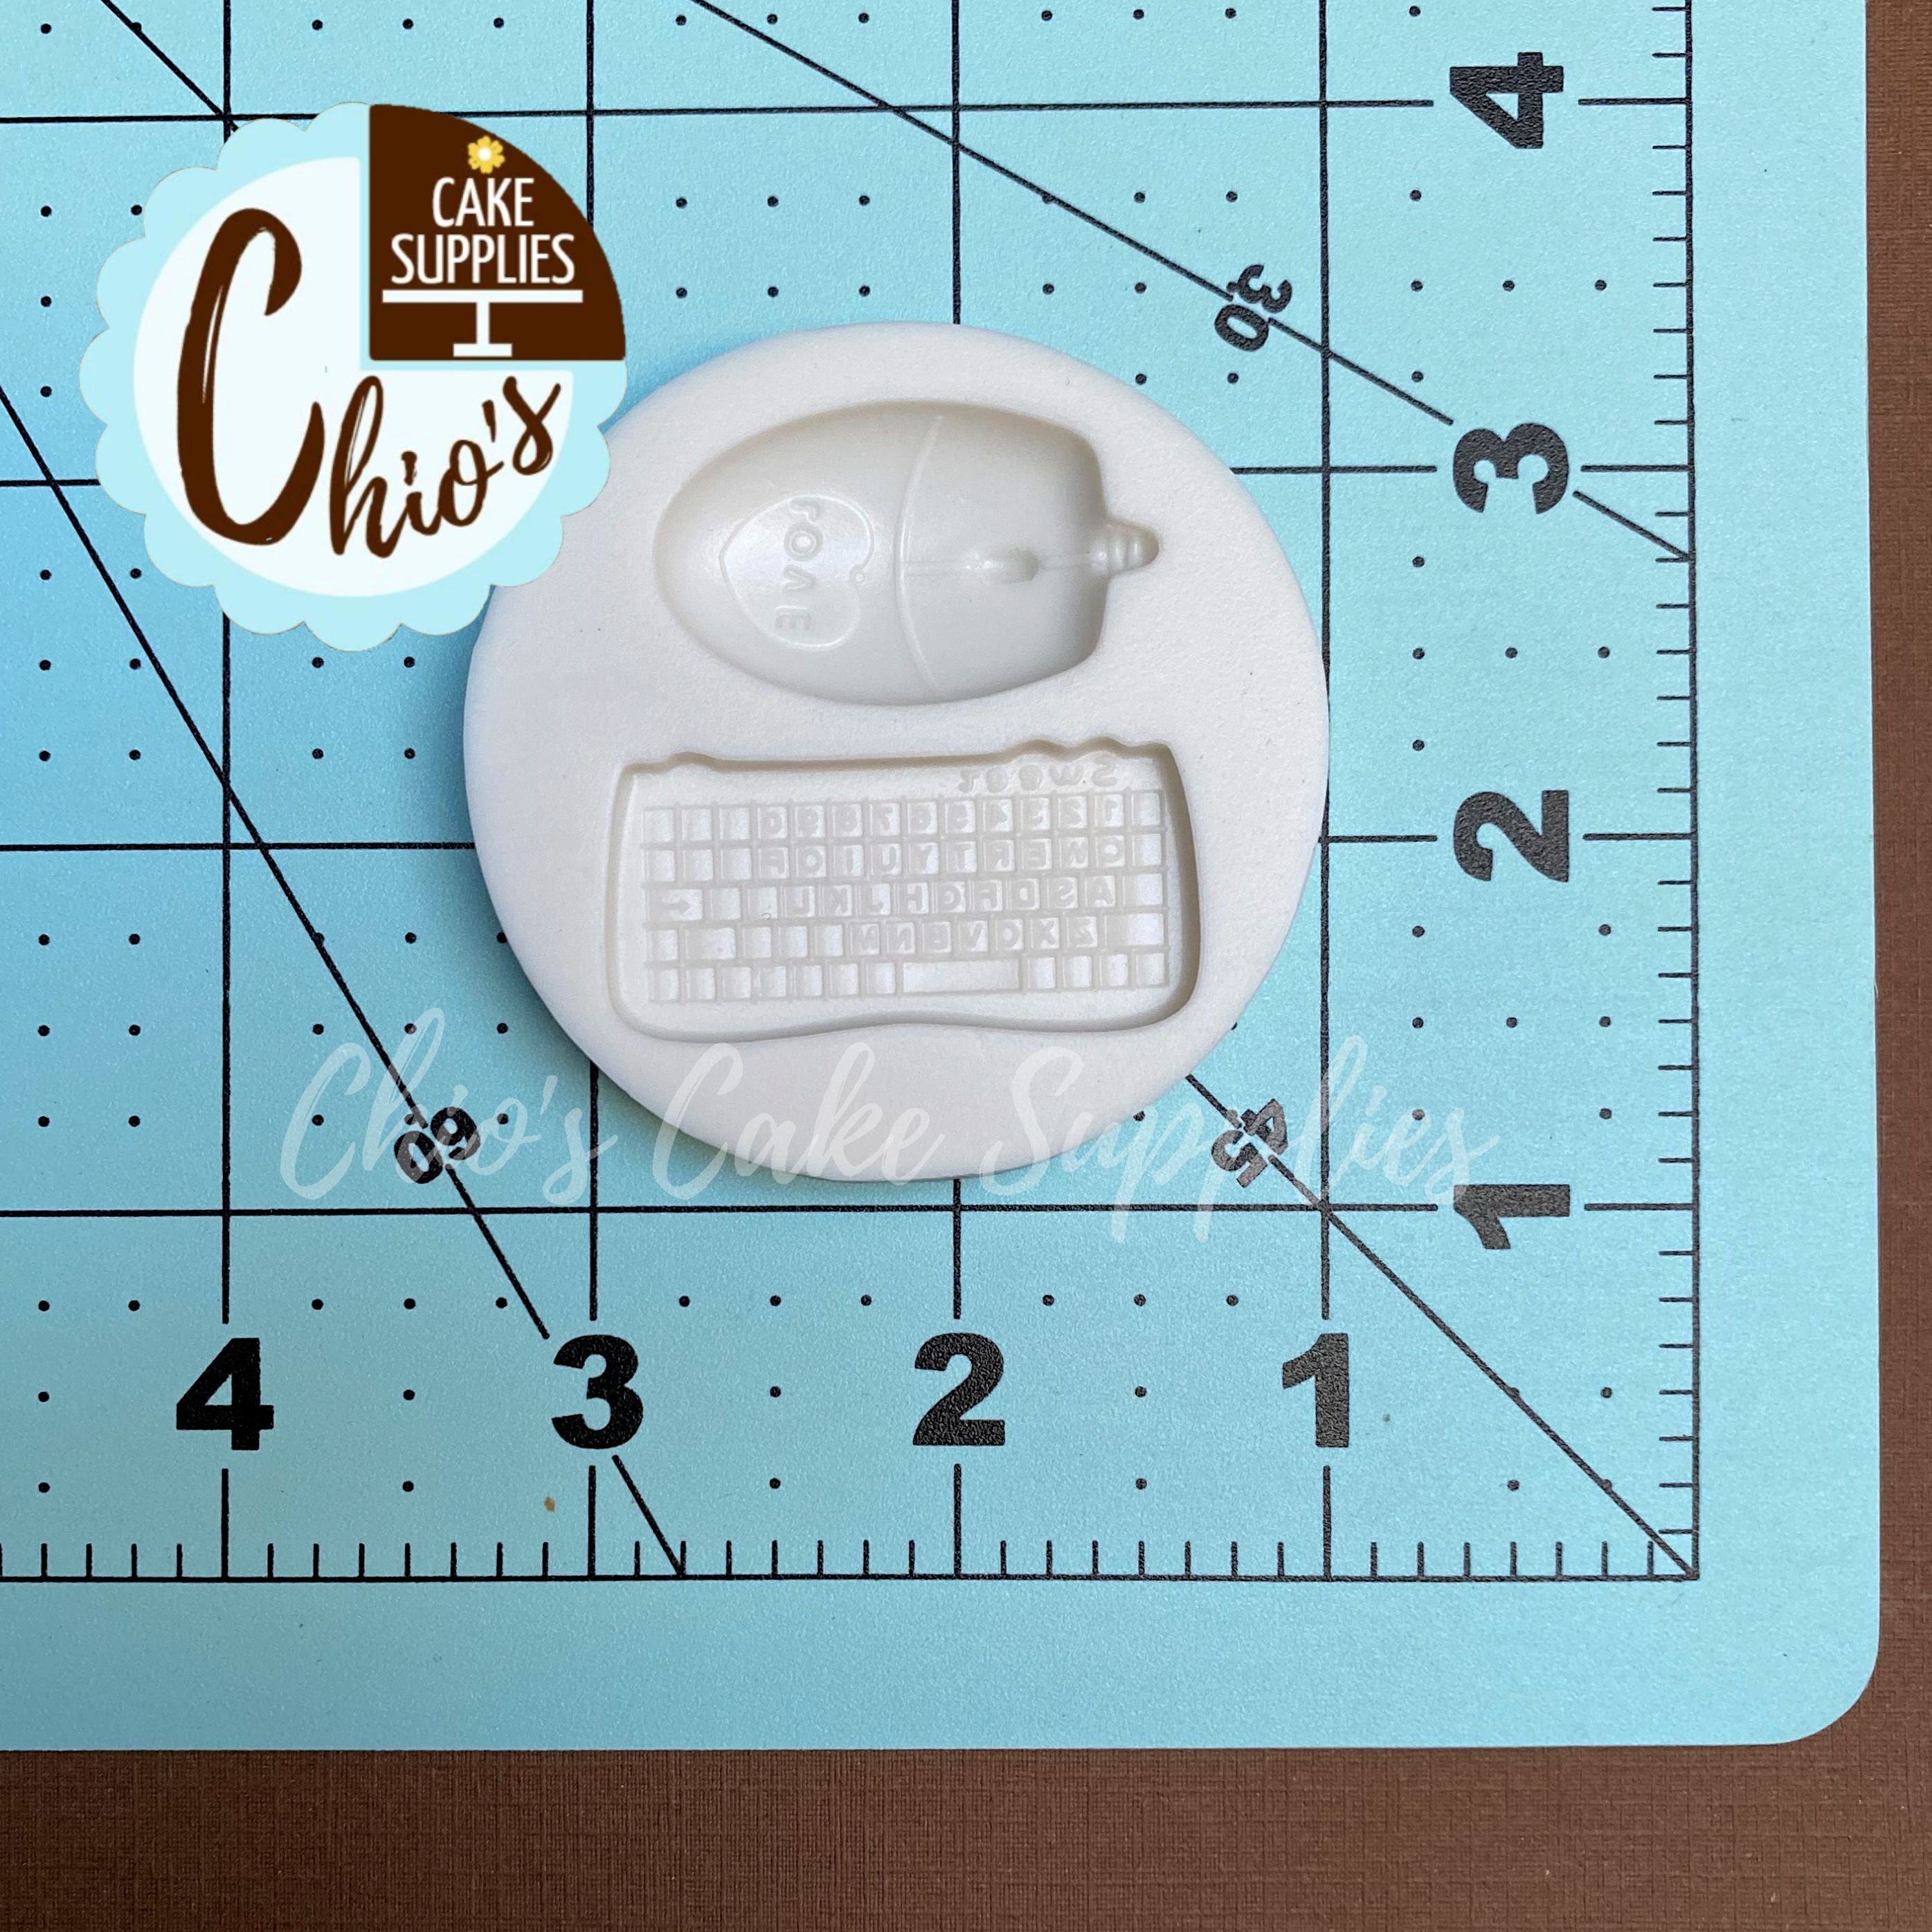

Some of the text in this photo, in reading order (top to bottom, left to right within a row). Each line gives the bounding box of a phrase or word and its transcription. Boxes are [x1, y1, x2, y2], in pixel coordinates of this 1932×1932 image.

[1450, 52, 1564, 149] 4
[1214, 264, 1292, 352] 30
[1453, 422, 1569, 514] 3
[1454, 790, 1569, 883] 2
[393, 1106, 480, 1184] 60
[1211, 1099, 1288, 1187] 45
[1454, 1184, 1570, 1249] 1
[176, 1332, 1351, 1452] 4 3 2 1
